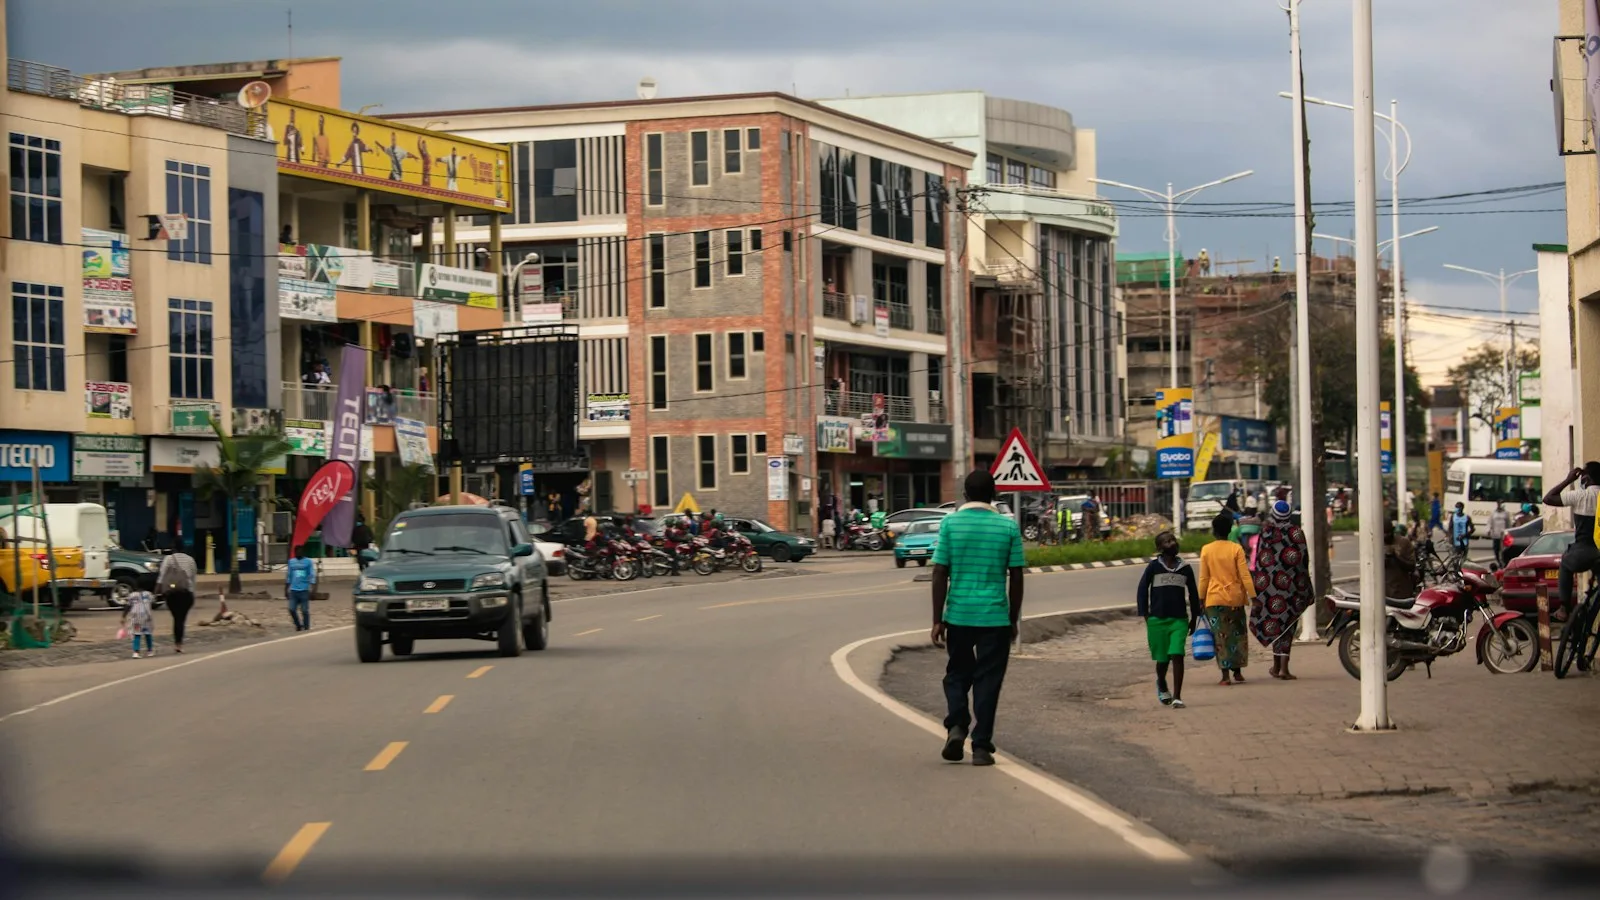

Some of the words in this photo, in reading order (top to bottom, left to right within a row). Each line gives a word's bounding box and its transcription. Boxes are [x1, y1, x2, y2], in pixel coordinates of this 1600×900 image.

[97, 280, 133, 291] DESIGNER
[92, 383, 128, 393] DESIGNER
[340, 396, 360, 467] TECN
[0, 443, 55, 468] TECNO
